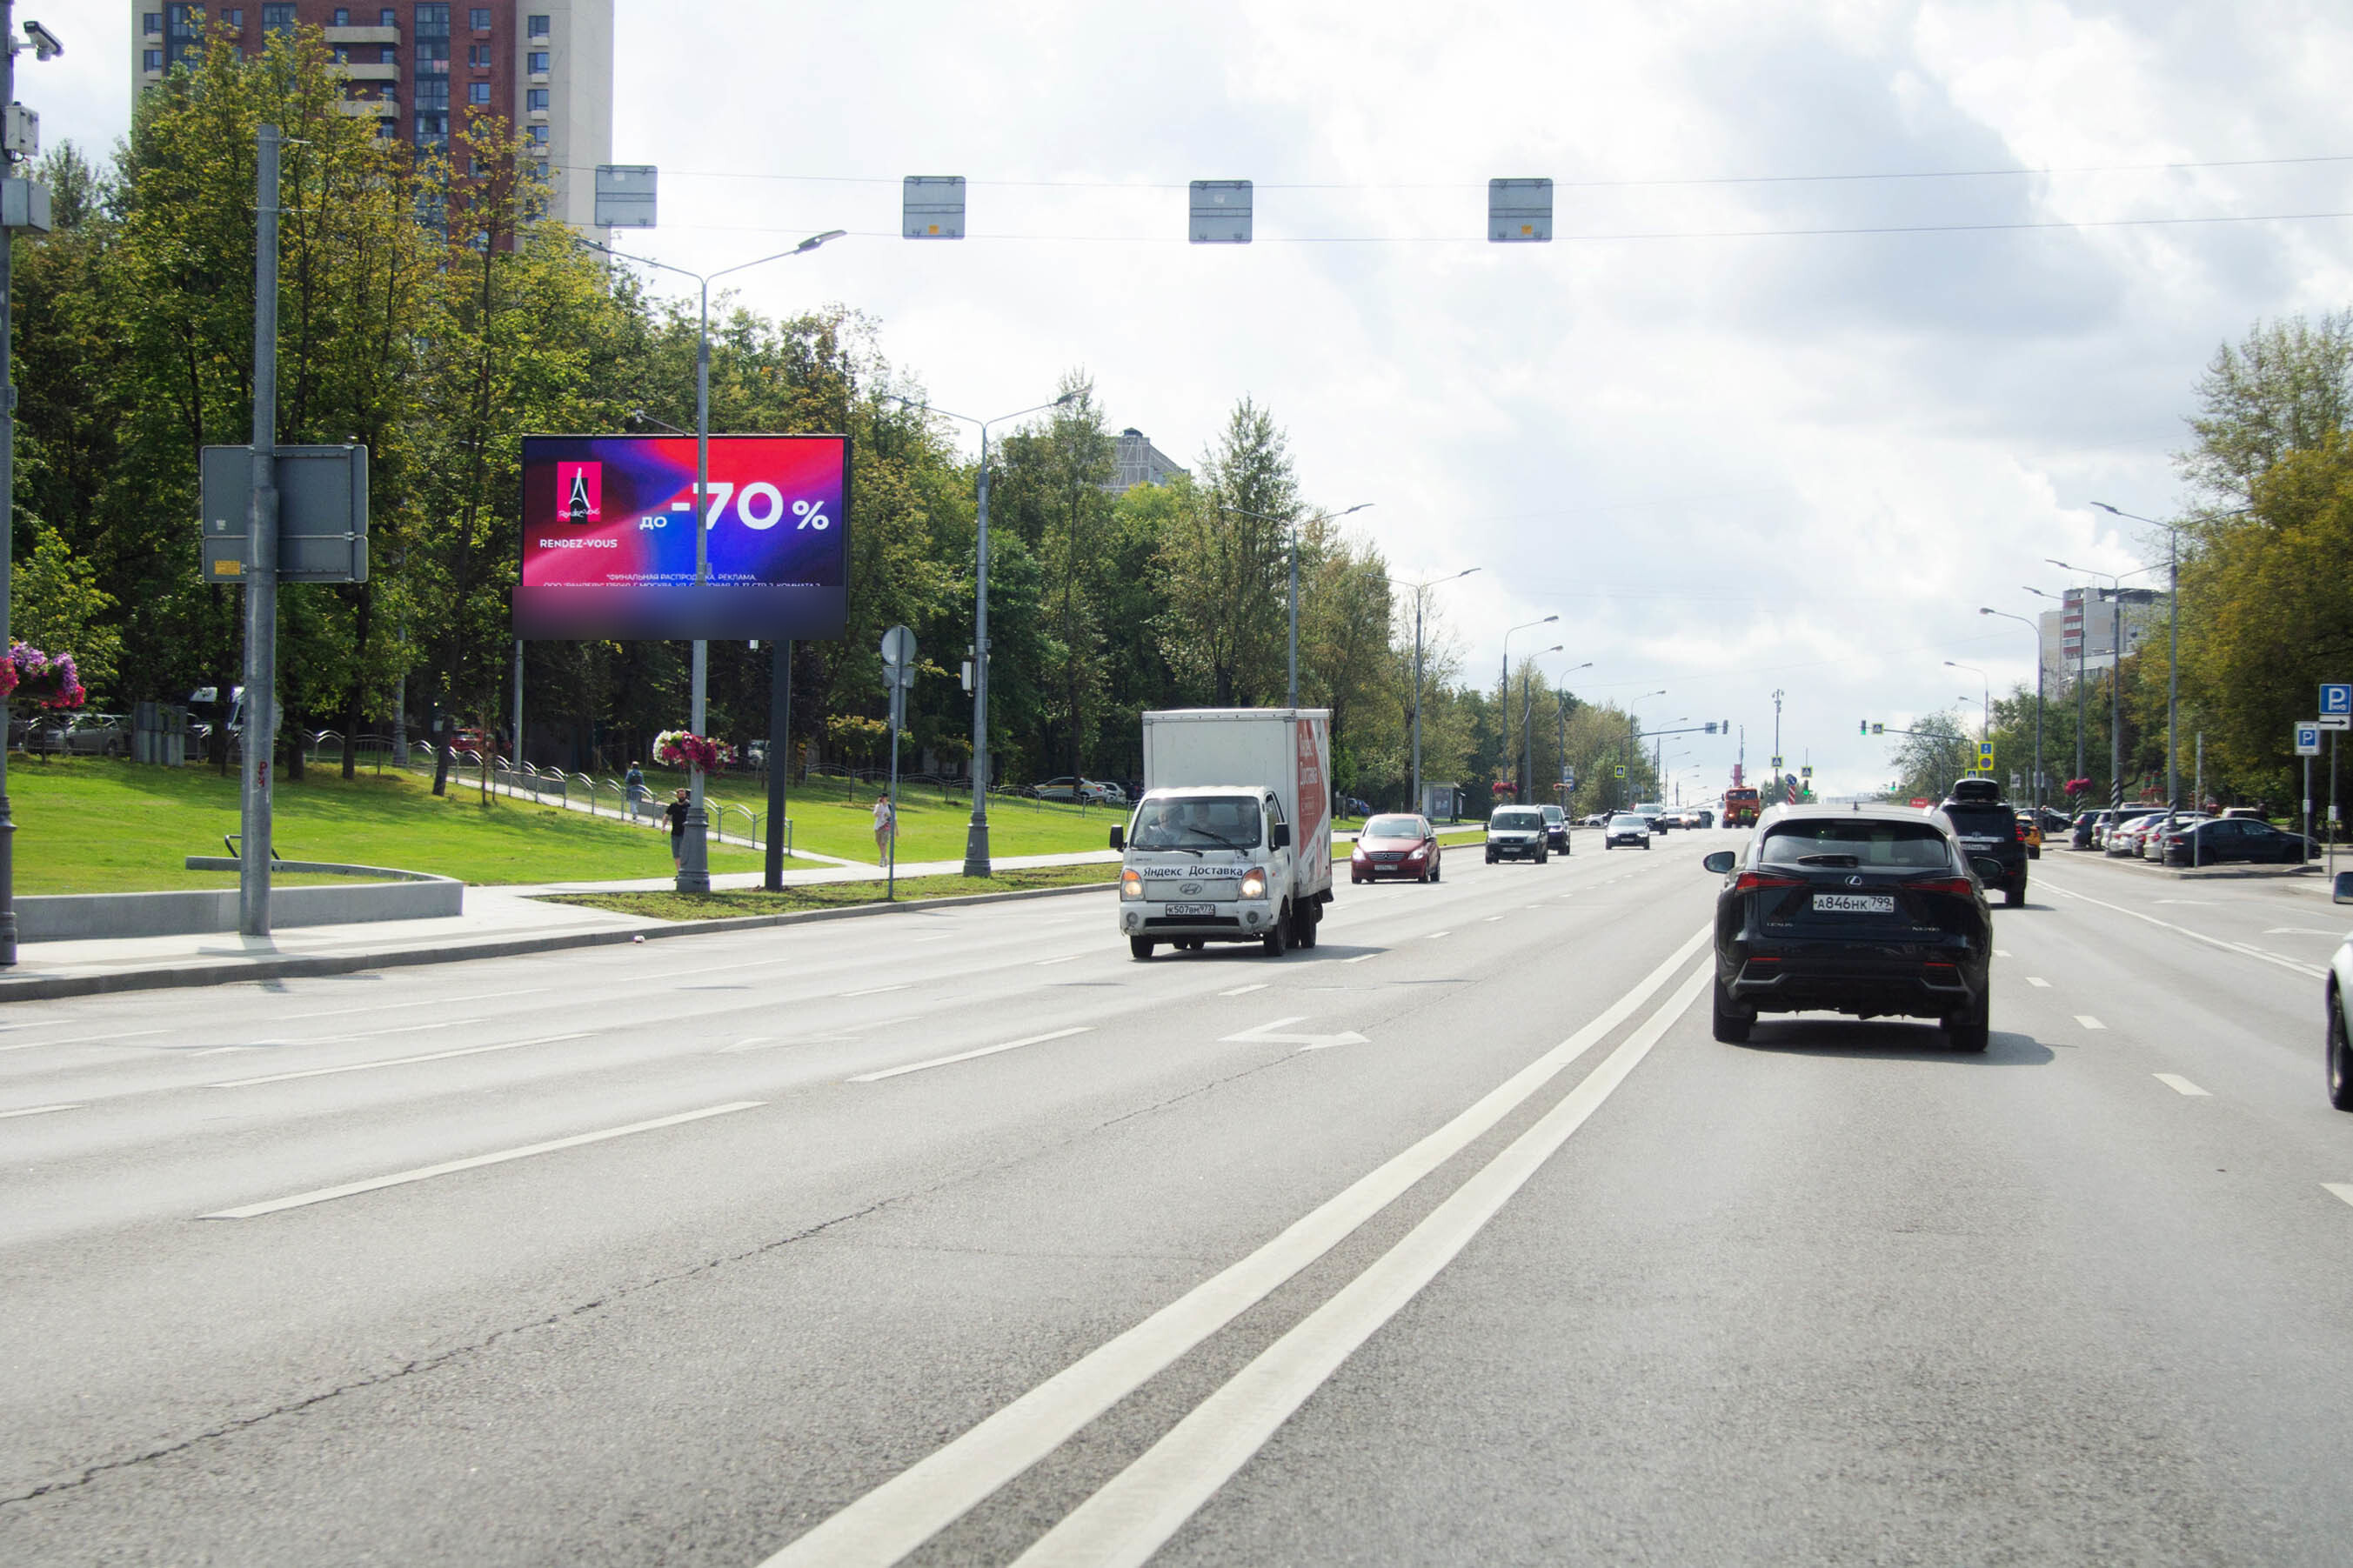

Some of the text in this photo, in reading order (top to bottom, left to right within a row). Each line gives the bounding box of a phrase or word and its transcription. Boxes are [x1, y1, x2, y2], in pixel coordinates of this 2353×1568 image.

[539, 538, 618, 549] RENDEZ-VOUS
[2328, 688, 2346, 711] P
[2303, 731, 2313, 745] P
[1143, 865, 1244, 877] Яндекс Доставка
